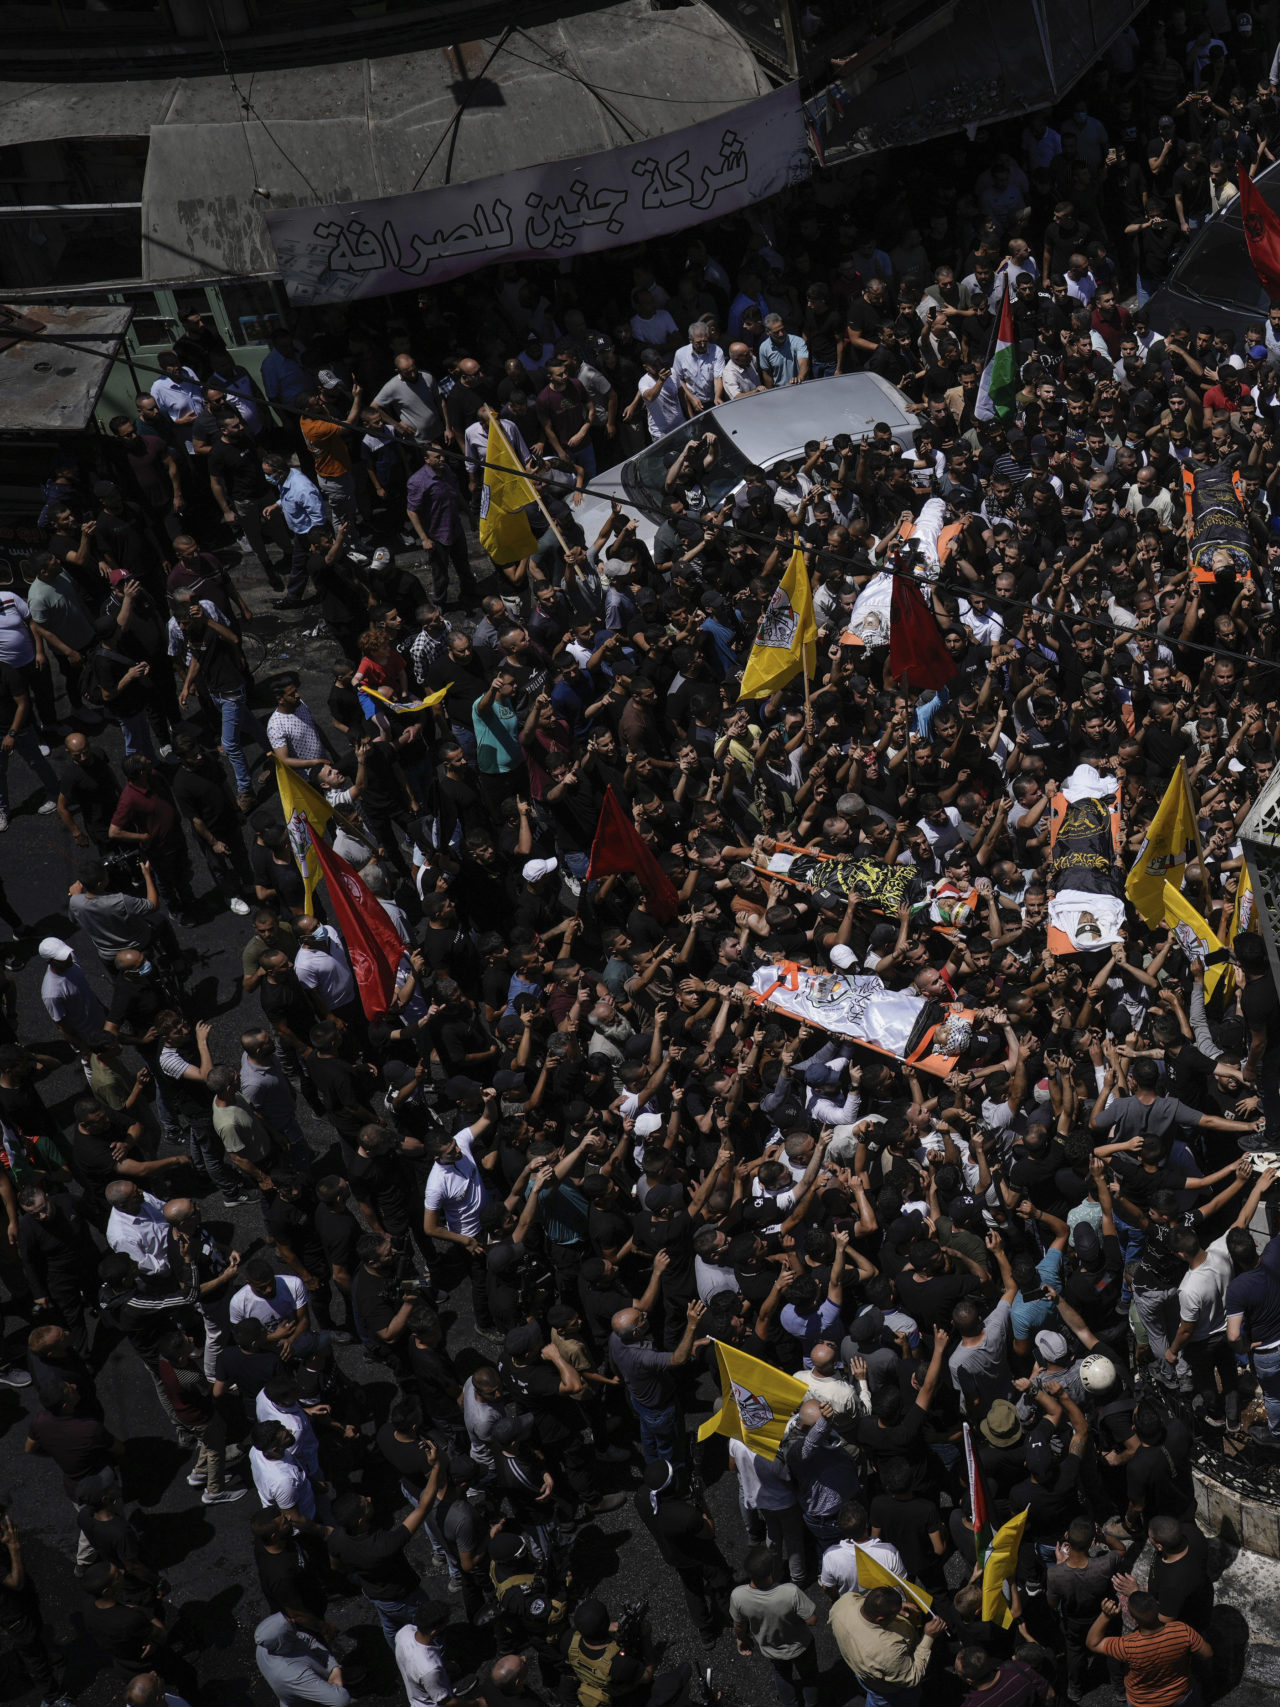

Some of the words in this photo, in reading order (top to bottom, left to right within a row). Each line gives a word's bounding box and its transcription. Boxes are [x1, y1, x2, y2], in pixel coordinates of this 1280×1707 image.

[632, 129, 748, 210] شركة
[314, 200, 513, 276] للصرافة
[525, 180, 628, 250] جنين
